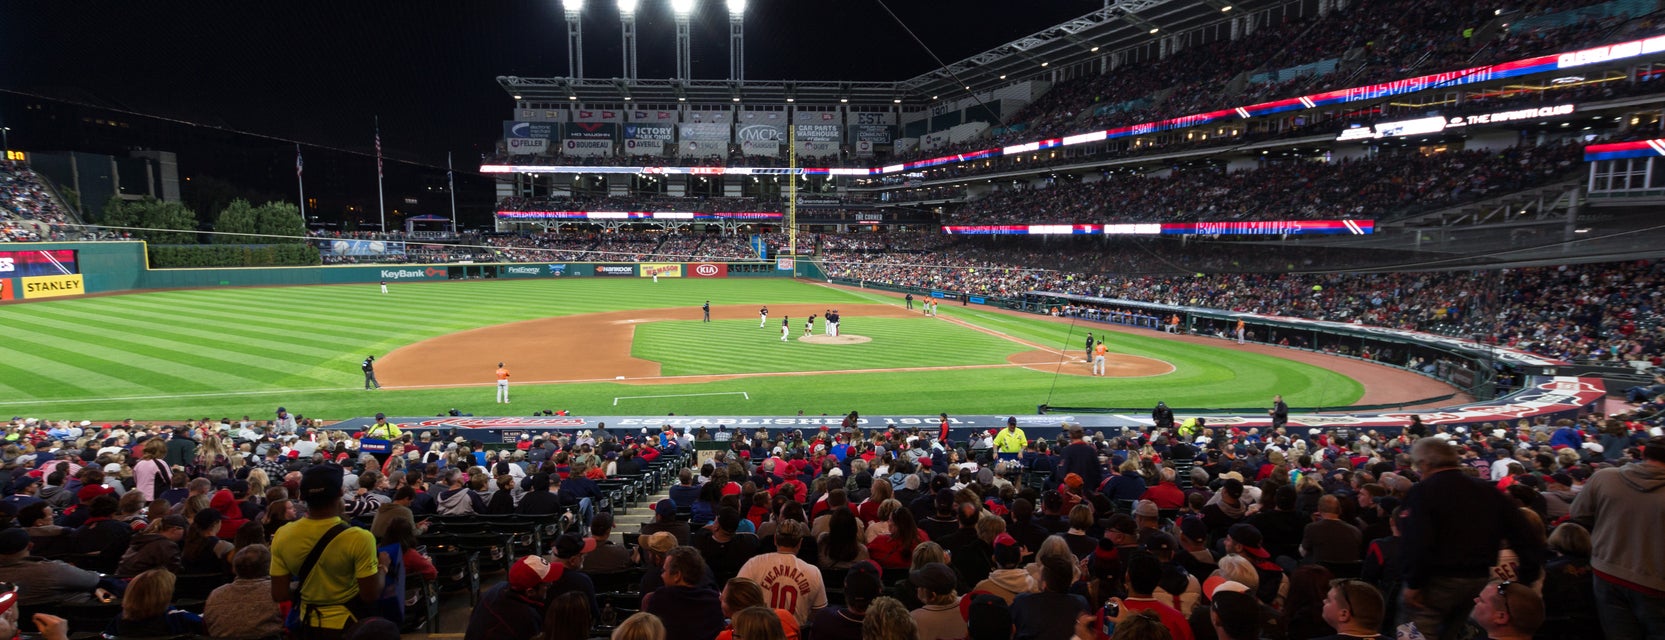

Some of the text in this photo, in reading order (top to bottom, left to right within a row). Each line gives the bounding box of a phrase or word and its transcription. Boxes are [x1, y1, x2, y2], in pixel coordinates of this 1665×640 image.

[858, 113, 886, 124] EST.
[1467, 114, 1491, 124] THE
[576, 141, 609, 149] BOUDREAU
[636, 140, 661, 148] AVERILL
[381, 269, 425, 279] KeyBank
[508, 266, 540, 274] FirstEnergy
[699, 266, 714, 274] KIA
[27, 280, 80, 293] STANLEY
[616, 417, 869, 425] ESTABLISHED
[761, 565, 811, 596] ENCARNACION
[770, 582, 798, 615] 10
